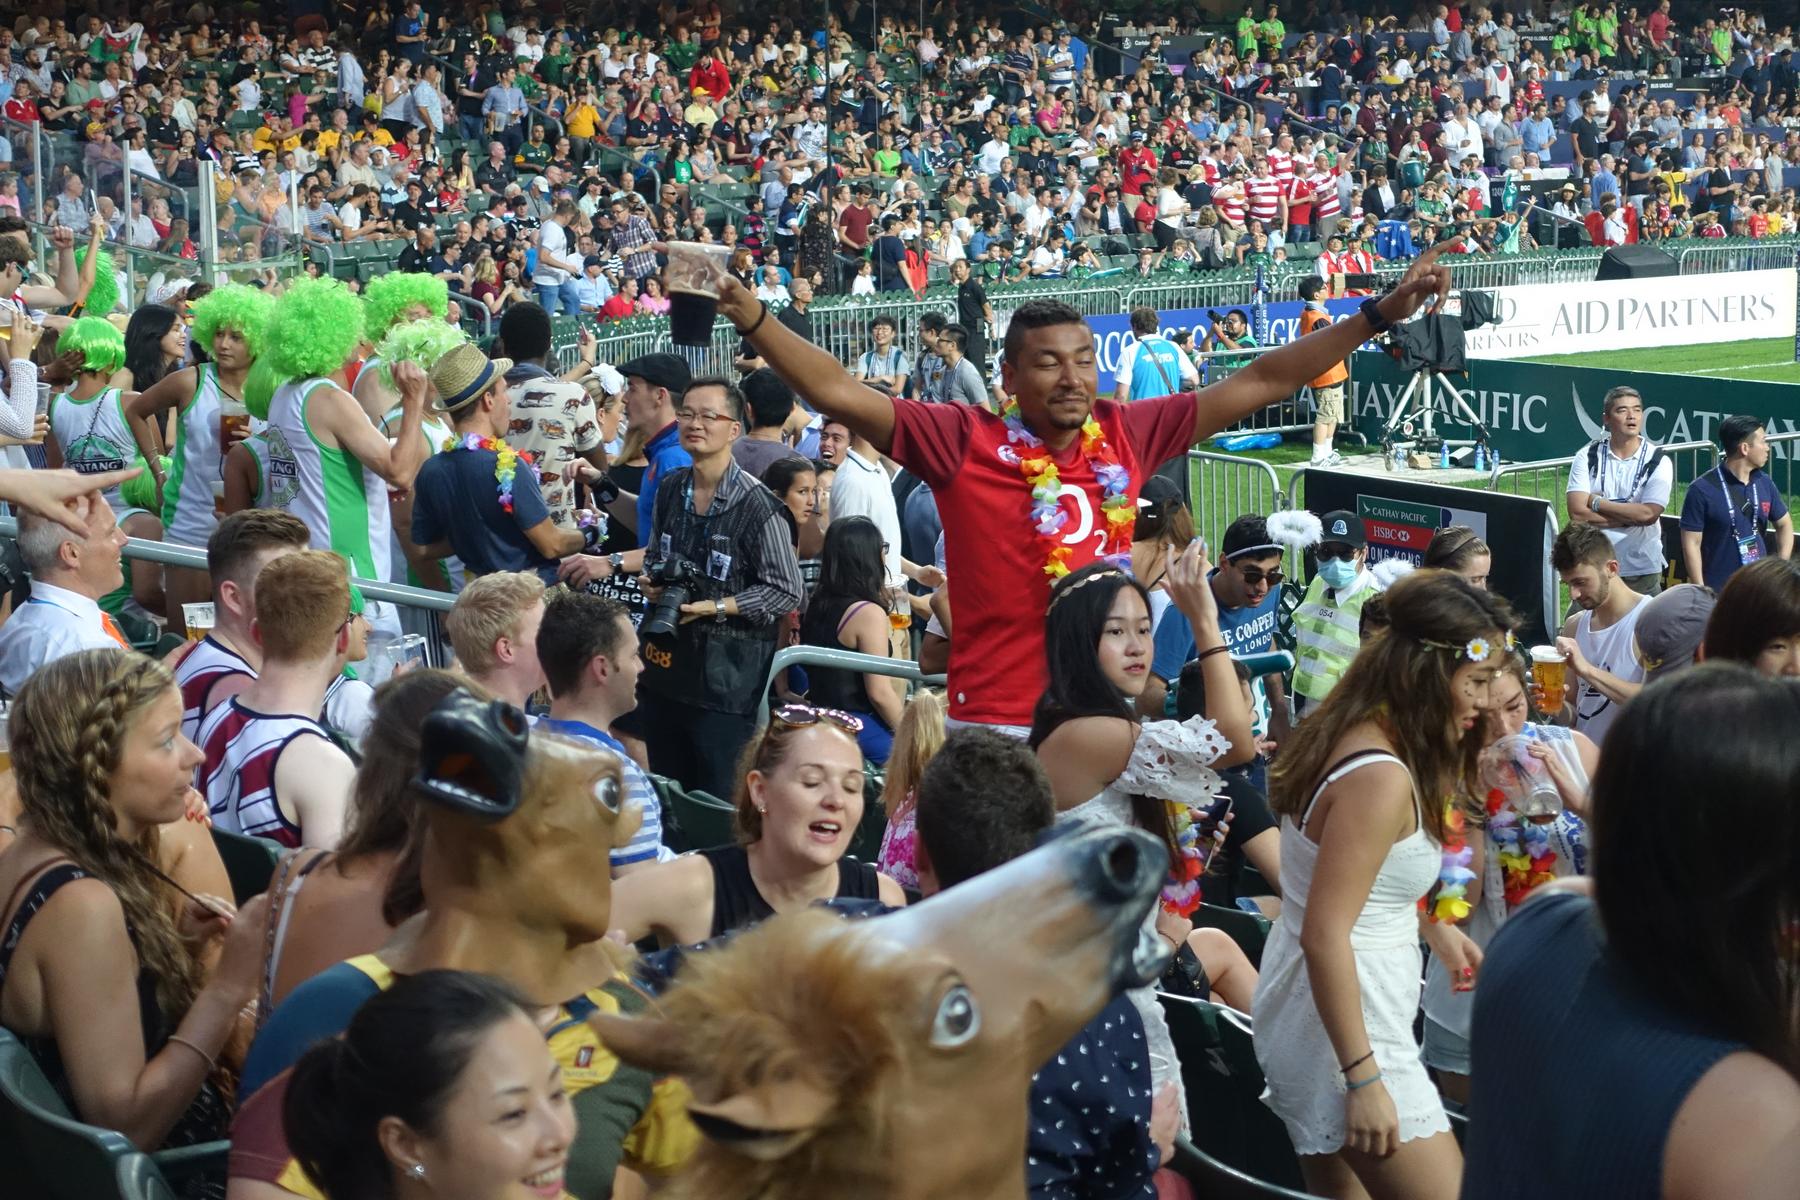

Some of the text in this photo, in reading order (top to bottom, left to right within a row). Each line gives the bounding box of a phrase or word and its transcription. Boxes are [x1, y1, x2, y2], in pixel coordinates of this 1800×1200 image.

[1552, 293, 1775, 336] AID PARTNERS
[1414, 386, 1548, 434] ACIFIC
[1642, 405, 1800, 461] CATAY
[1372, 507, 1428, 523] CATHAY PACIFIC
[1373, 525, 1398, 540] HSBC
[1235, 610, 1274, 642] COOPER
[1319, 607, 1334, 619] 054
[645, 641, 672, 669] 038
[1245, 631, 1272, 653] LONDO
